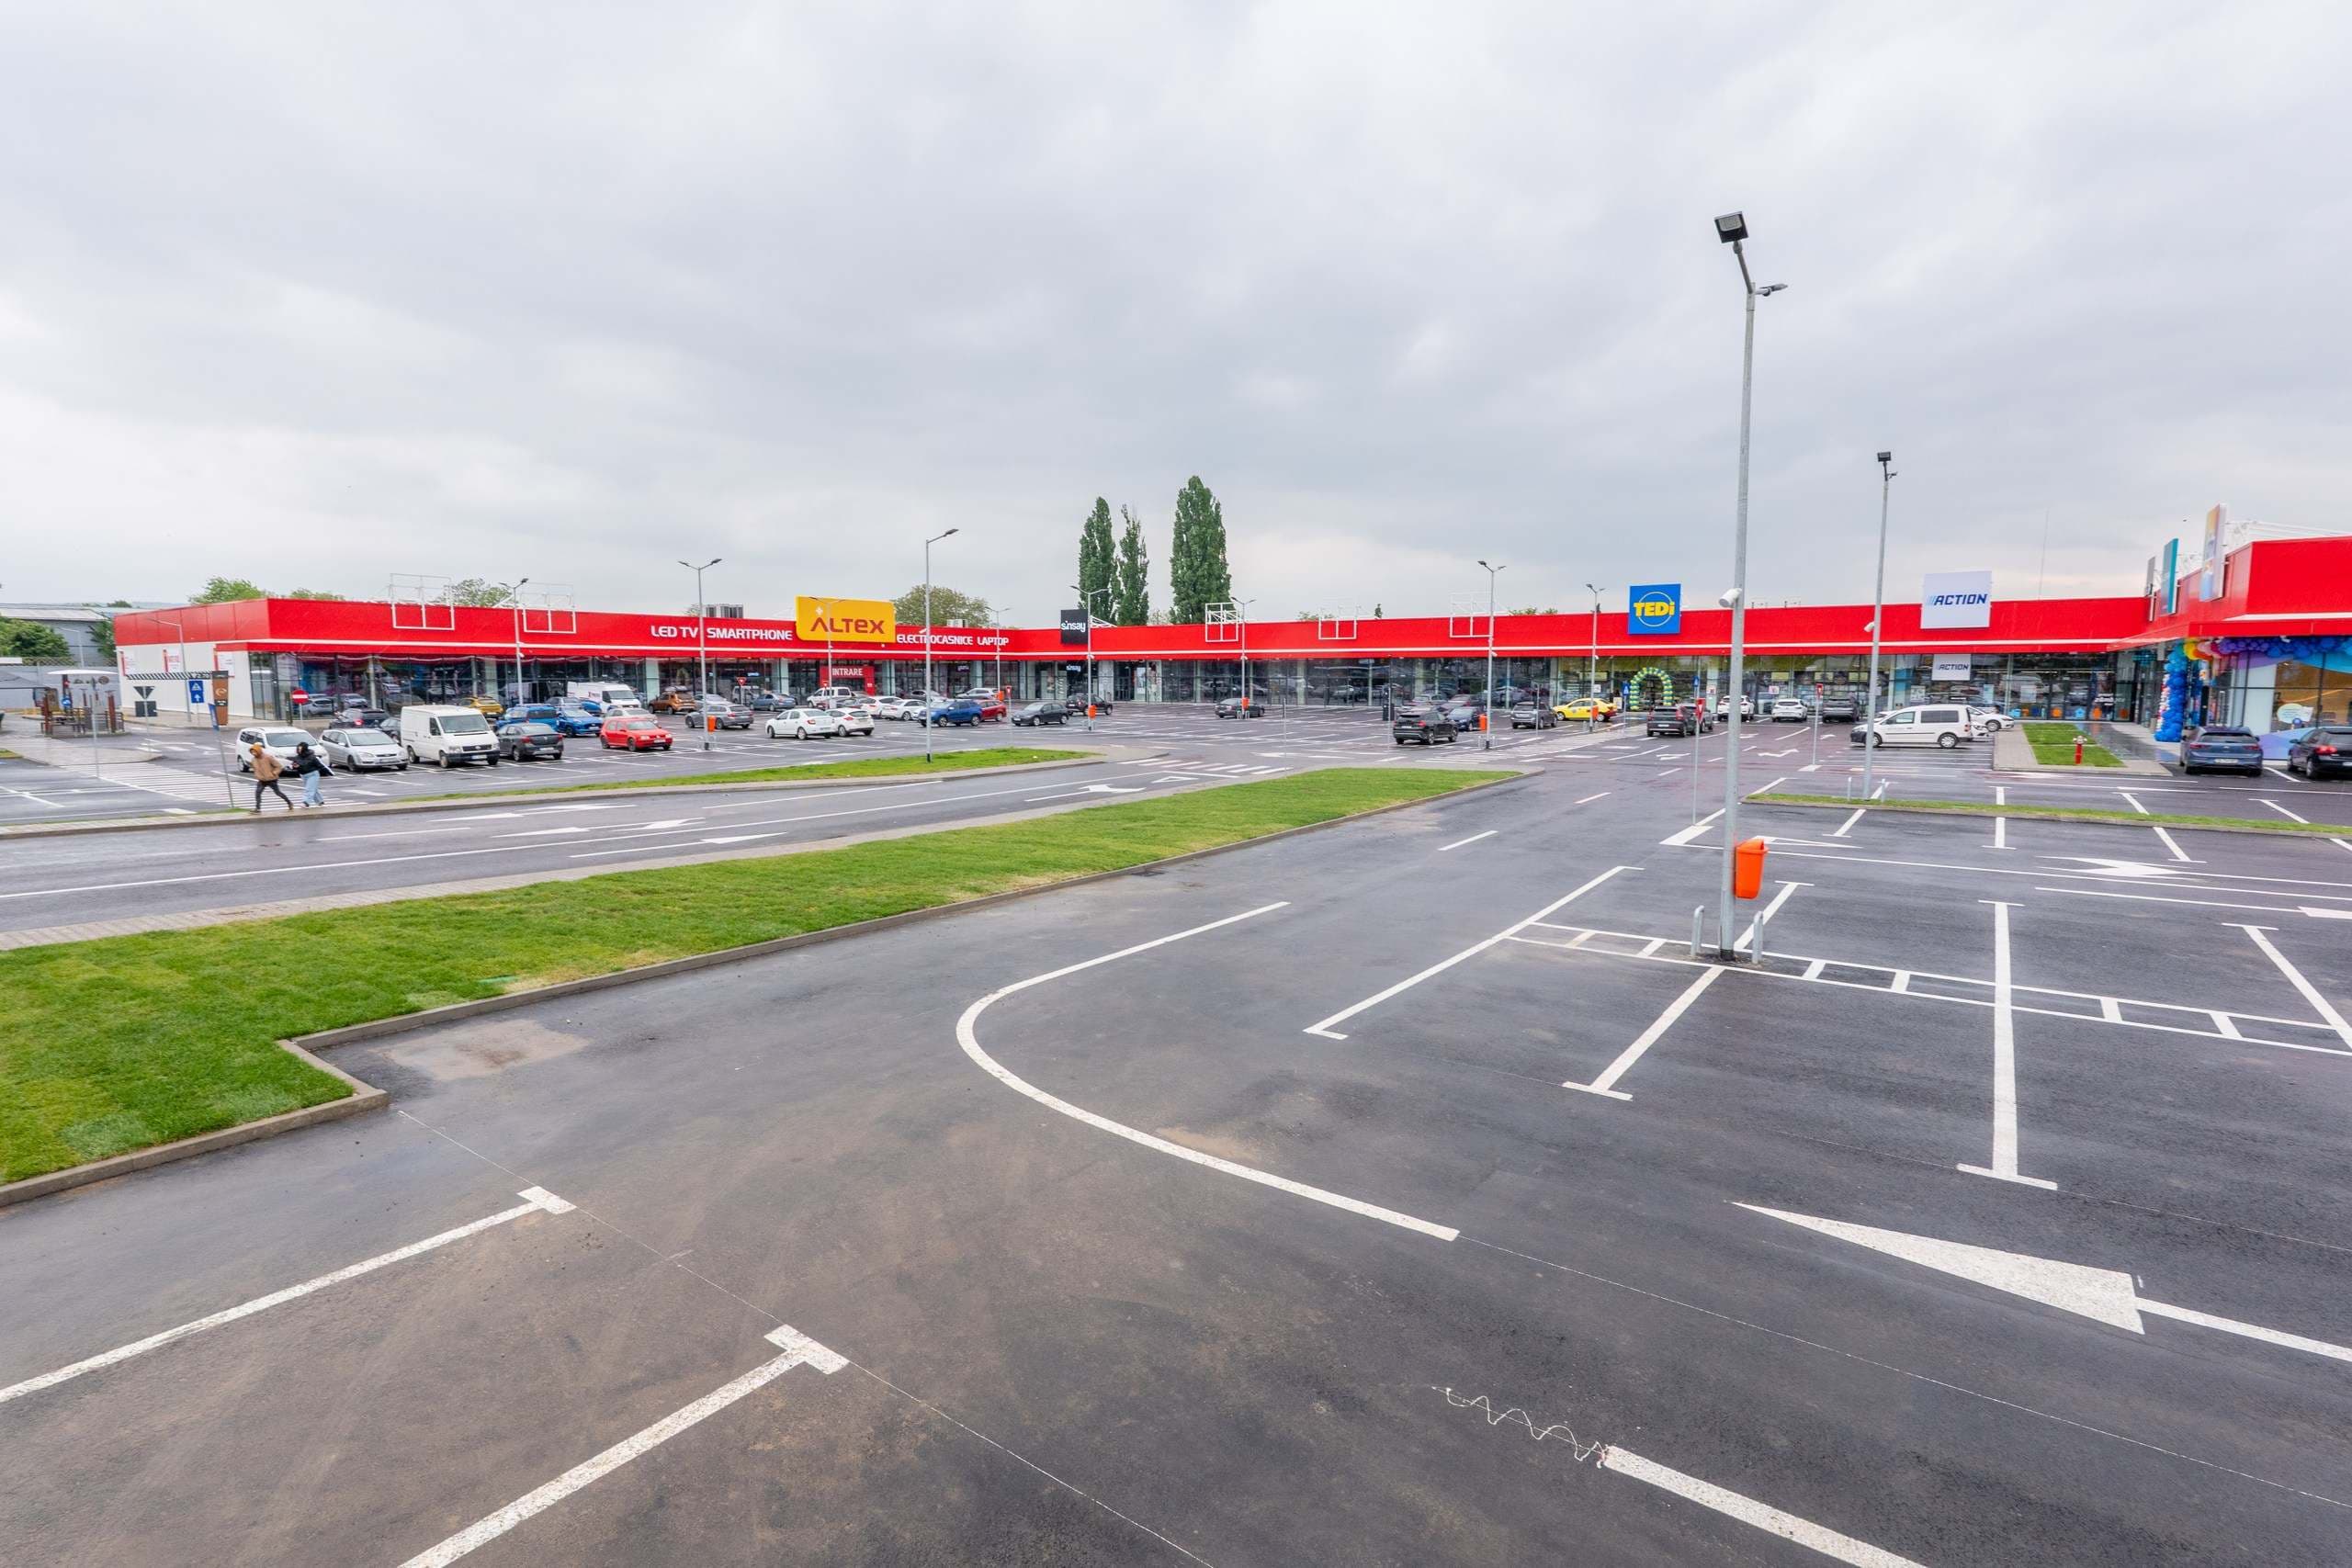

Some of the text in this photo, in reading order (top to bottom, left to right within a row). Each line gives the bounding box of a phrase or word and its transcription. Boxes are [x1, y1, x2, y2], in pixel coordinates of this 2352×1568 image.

[1933, 593, 1988, 606] ACTION
[1060, 620, 1086, 633] sinsay
[650, 626, 793, 641] LED TV SMARTPHONE
[977, 636, 1010, 646] LAPTOP
[831, 668, 864, 677] INTRARE
[1939, 663, 1970, 671] ACTION
